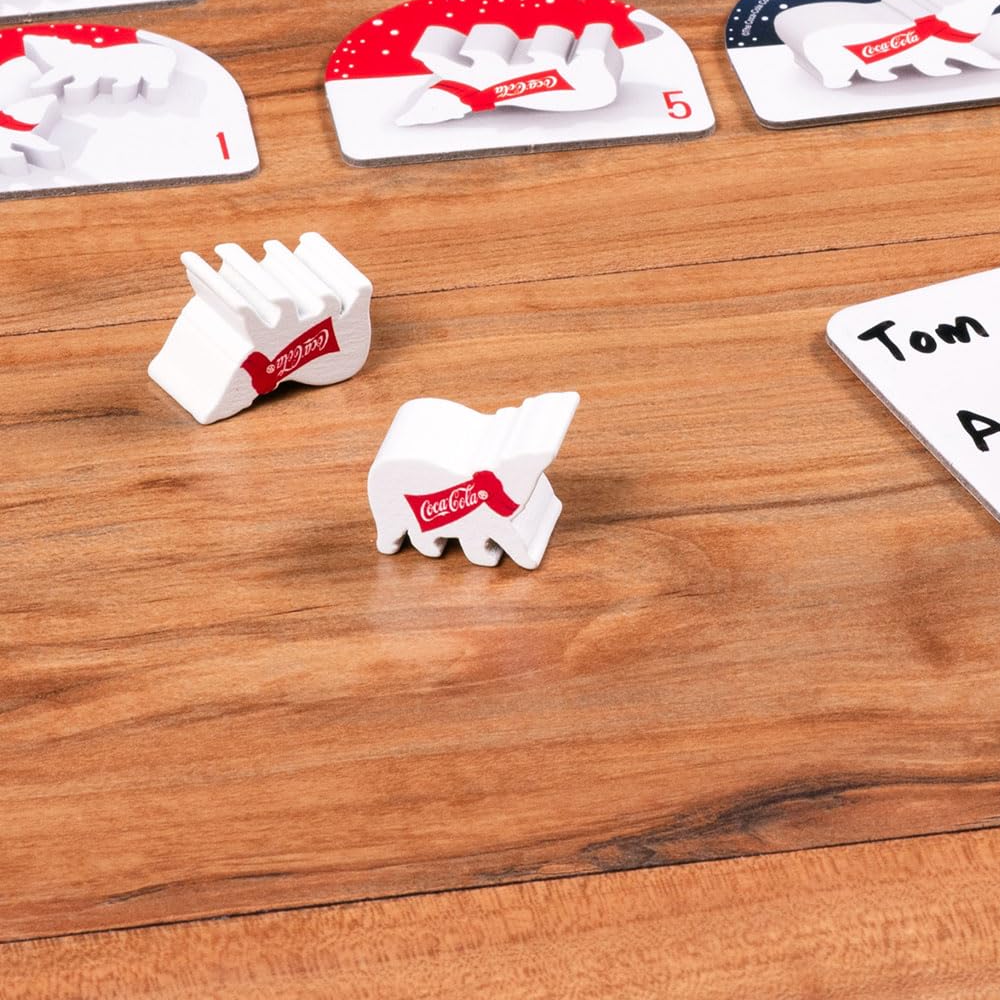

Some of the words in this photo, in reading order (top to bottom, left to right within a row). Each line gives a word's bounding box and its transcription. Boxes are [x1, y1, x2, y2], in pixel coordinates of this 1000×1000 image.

[861, 32, 920, 59] Coca-Cola
[494, 75, 558, 99] Coca-Cola
[663, 90, 692, 119] 5
[216, 131, 230, 160] 1
[858, 315, 990, 361] Tom
